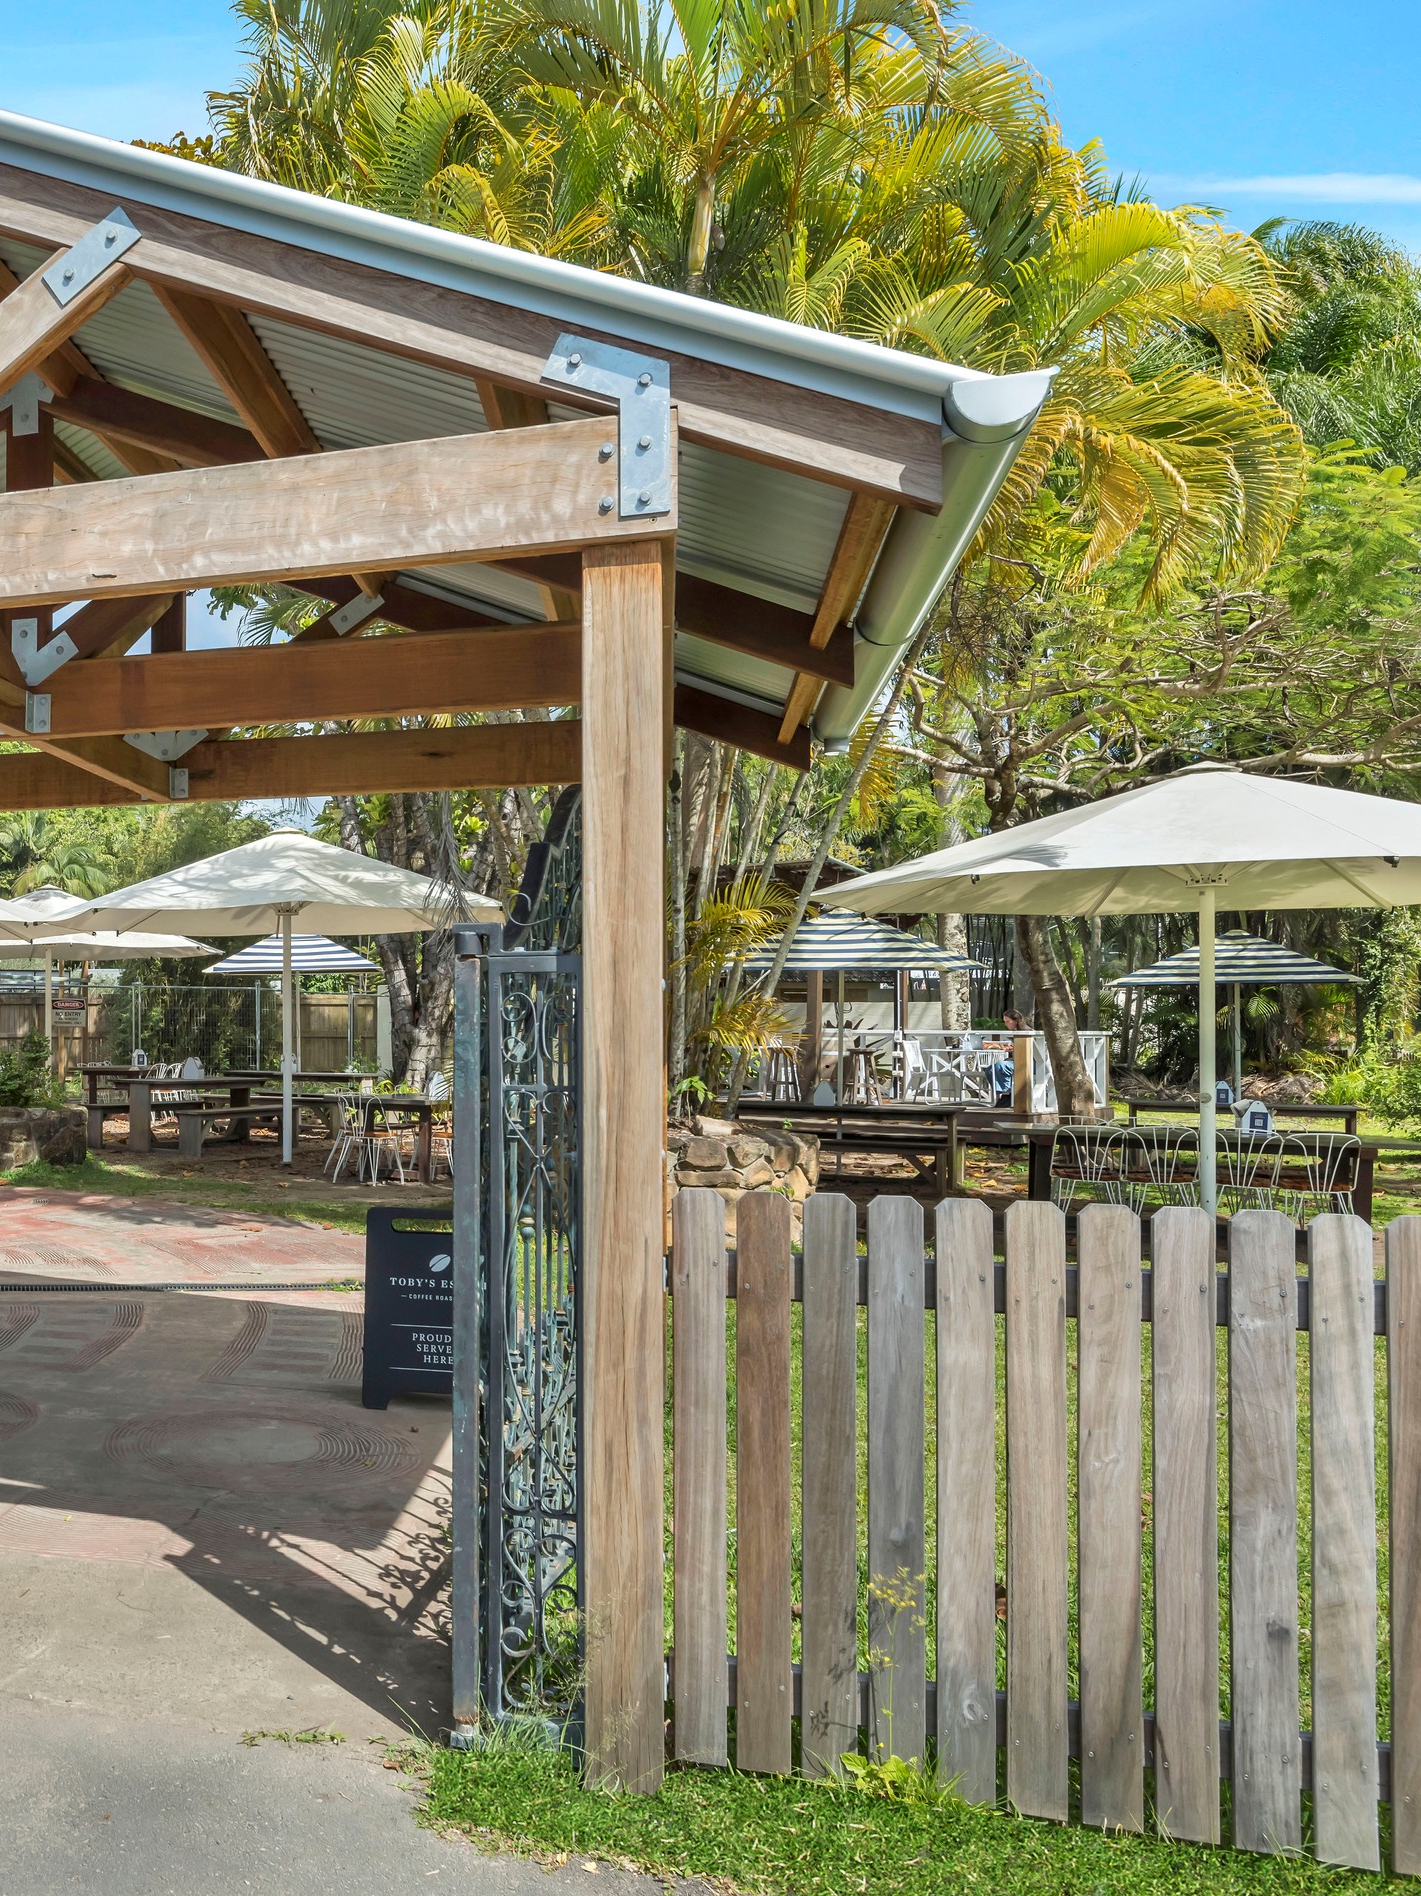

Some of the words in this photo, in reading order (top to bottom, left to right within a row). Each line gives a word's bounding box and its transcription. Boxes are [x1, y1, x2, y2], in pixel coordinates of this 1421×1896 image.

[390, 1277, 436, 1288] TOBY'S
[412, 1332, 452, 1343] PROUD
[416, 1343, 452, 1354] SERVE
[423, 1354, 454, 1365] HERE
